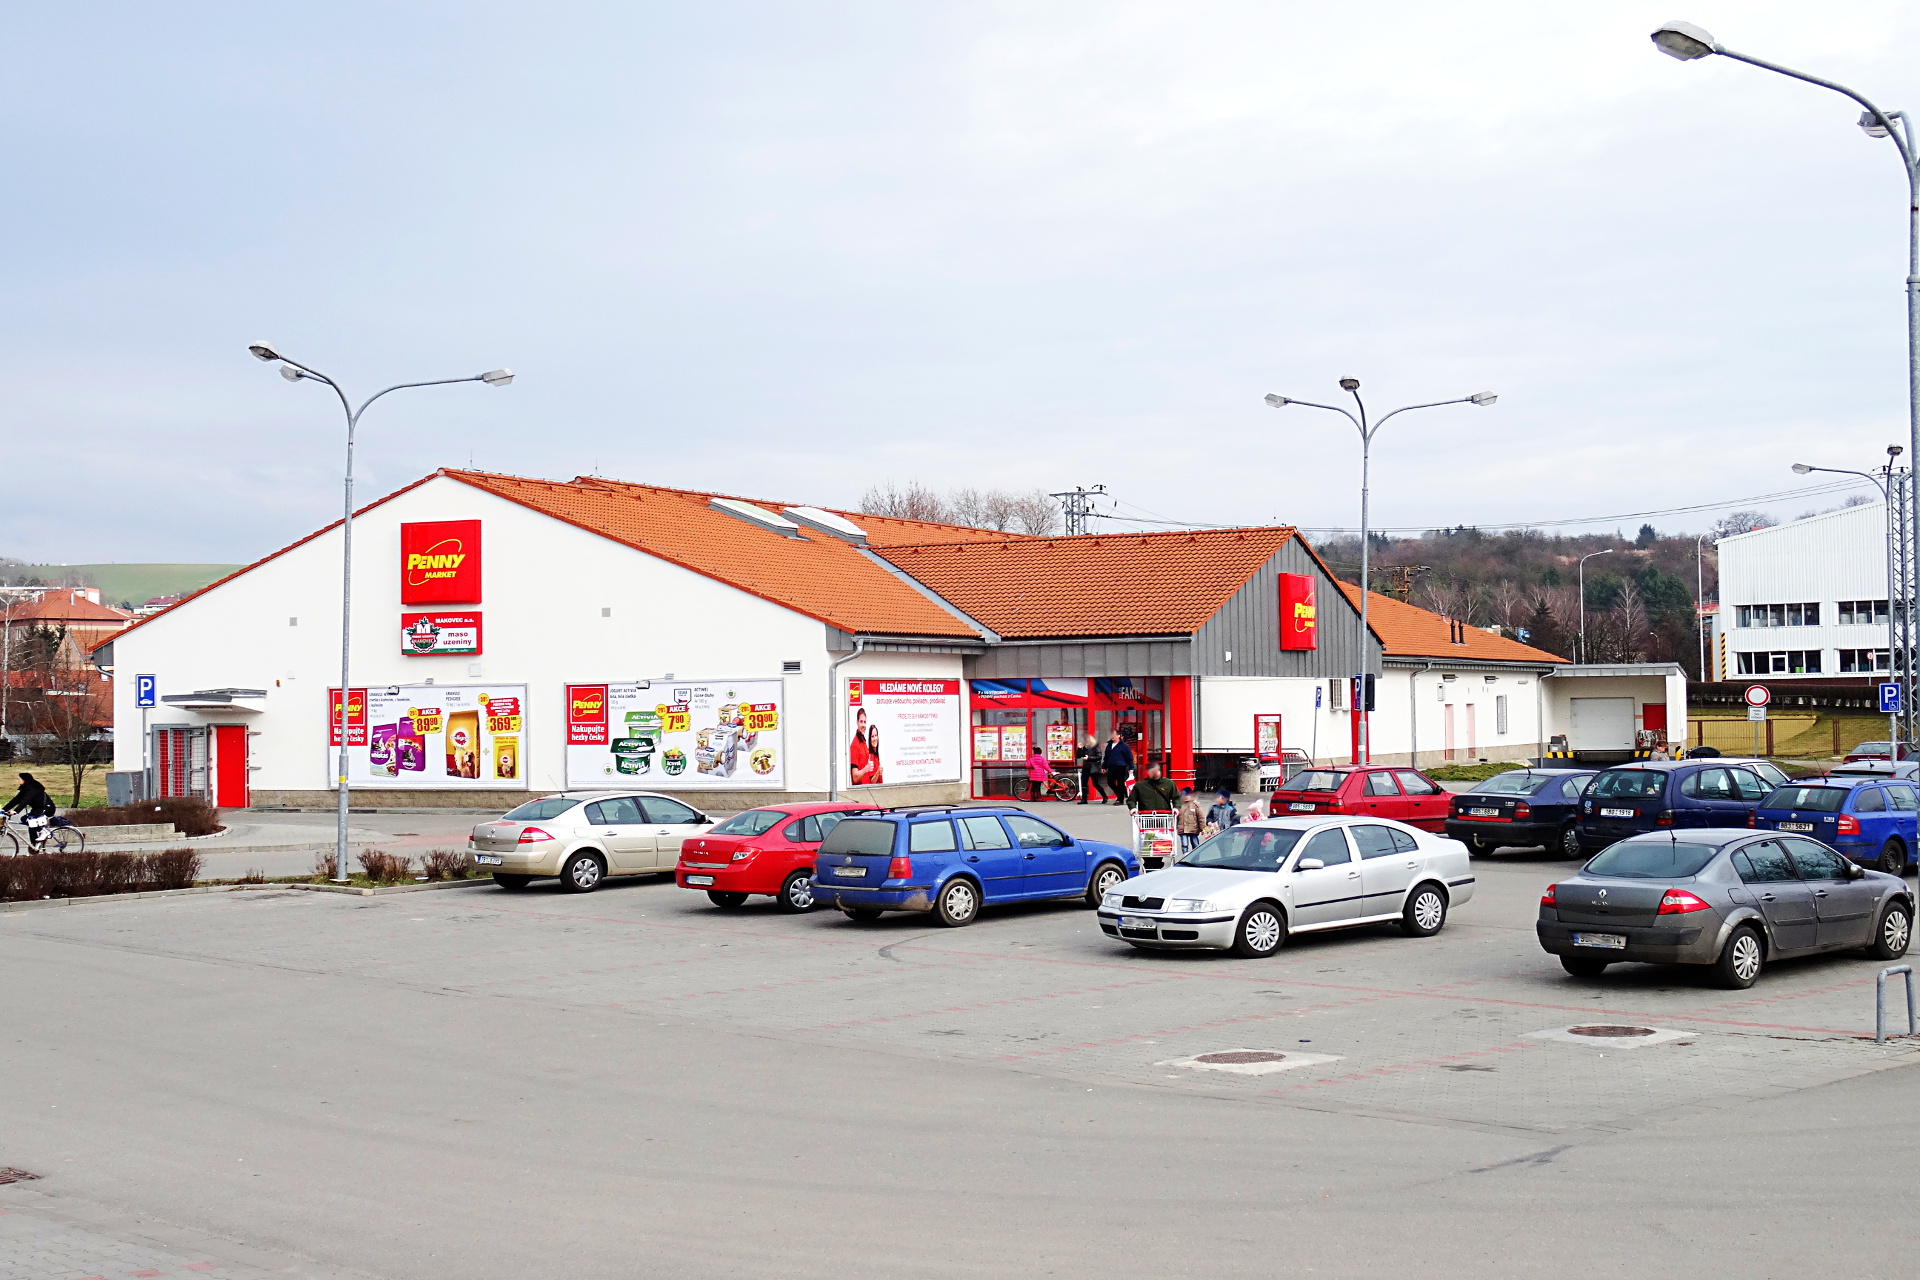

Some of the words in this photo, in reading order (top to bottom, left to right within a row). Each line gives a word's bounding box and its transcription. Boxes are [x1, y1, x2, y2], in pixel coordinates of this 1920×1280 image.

[407, 554, 465, 570] PENNY
[416, 624, 430, 634] M
[140, 678, 152, 698] P
[880, 682, 907, 692] HLEDÁME
[907, 682, 922, 692] NOVÉ
[923, 684, 944, 693] KOLEGY
[1884, 686, 1897, 703] P
[573, 700, 603, 708] PENNY
[334, 727, 364, 735] Napujte
[572, 725, 604, 734] Nakupujte
[572, 734, 588, 742] hezky
[589, 734, 604, 742] česky
